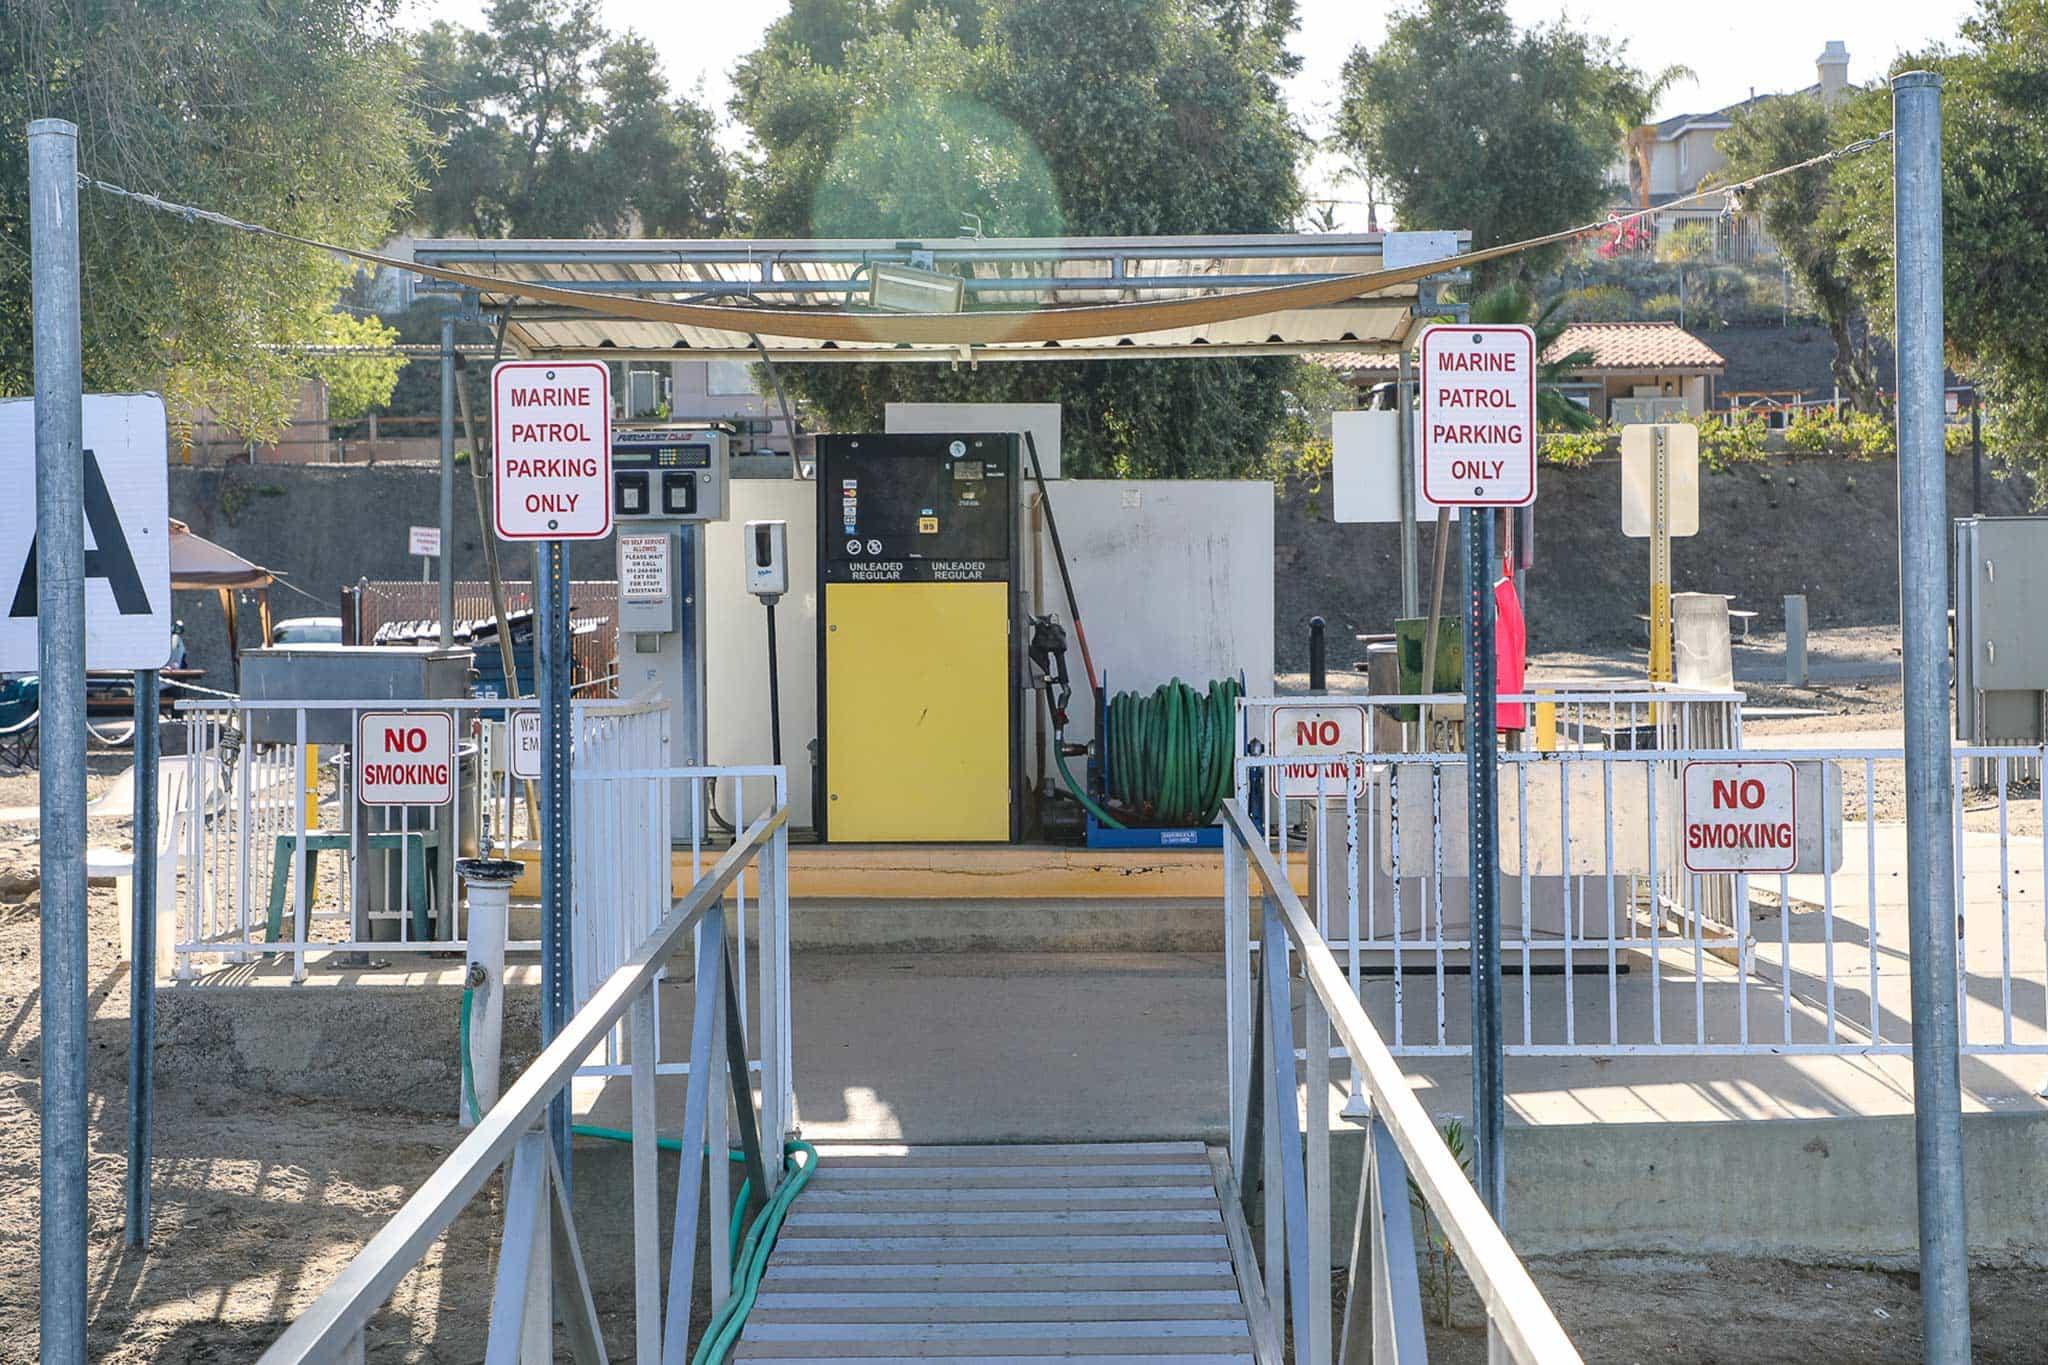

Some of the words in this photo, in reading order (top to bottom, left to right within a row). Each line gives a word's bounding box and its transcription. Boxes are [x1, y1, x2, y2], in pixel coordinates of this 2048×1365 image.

[1439, 352, 1516, 371] MARINE
[511, 388, 590, 407] MARINE
[1439, 389, 1517, 408] PATROL
[512, 424, 591, 442] PATROL
[1433, 424, 1522, 444] PARKING
[506, 458, 597, 478] PARKING
[1451, 460, 1504, 480] ONLY
[525, 494, 579, 513] ONLY
[8, 449, 153, 618] A
[849, 562, 903, 571] UNLEADED
[852, 571, 901, 580] REGULAR
[931, 562, 985, 571] UNLEADED
[934, 571, 983, 580] REGULAR
[384, 728, 427, 753] NO
[1296, 720, 1340, 746] NO
[365, 764, 448, 785] SMOKING
[1712, 779, 1765, 809] NO
[1688, 823, 1792, 849] SMOKING
